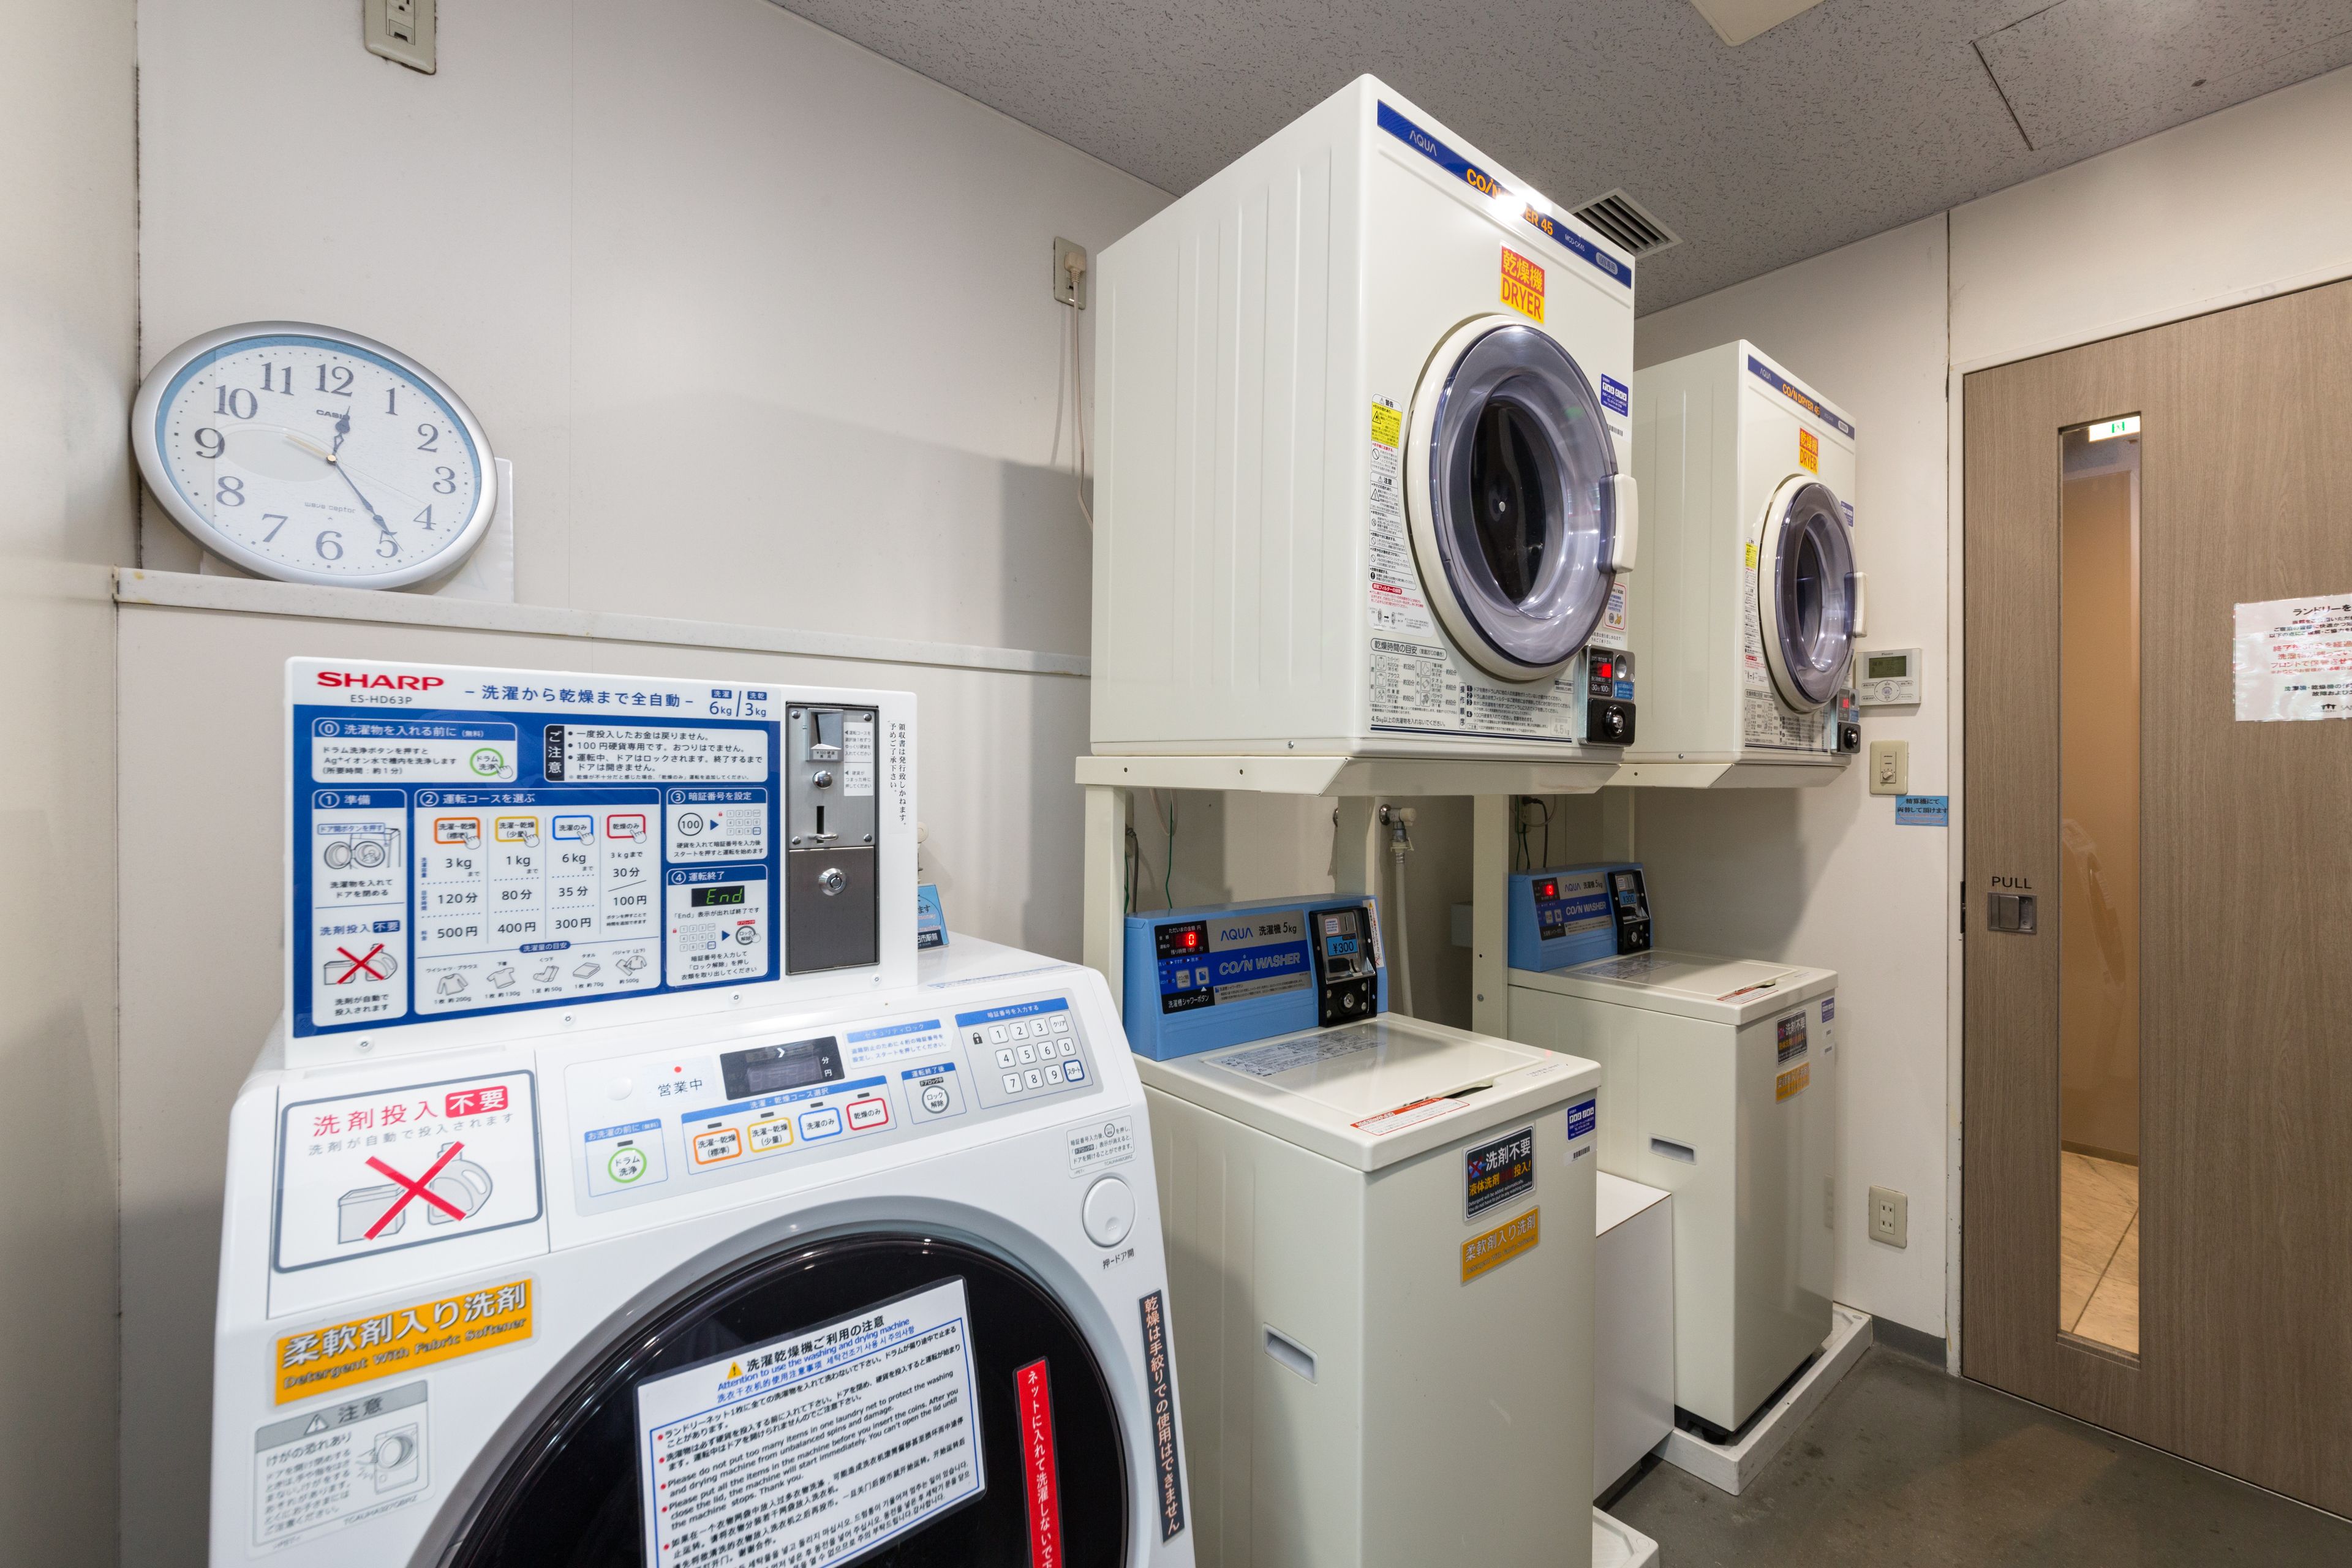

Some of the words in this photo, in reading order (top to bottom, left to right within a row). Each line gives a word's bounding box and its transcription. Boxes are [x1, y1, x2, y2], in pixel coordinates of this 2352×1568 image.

[1409, 130, 1437, 156] AQUA
[1541, 219, 1553, 235] 45
[1503, 250, 1542, 293] 乾燥機
[1502, 276, 1542, 319] DRYER
[260, 362, 294, 396] 11
[315, 364, 354, 397] 12
[214, 385, 258, 419] 10
[385, 387, 398, 415] 1
[1798, 394, 1813, 412] DRYER
[1814, 405, 1819, 416] 45
[195, 428, 225, 458] 9
[417, 424, 439, 452] 2
[1800, 450, 1817, 472] DRYER
[432, 467, 456, 494] 3
[216, 476, 245, 507] 8
[305, 502, 325, 510] wave
[328, 505, 356, 513] ceptor
[413, 503, 435, 530] 4
[262, 513, 288, 543] 7
[316, 530, 343, 560] 6
[376, 532, 398, 558] 5
[1374, 641, 1417, 655] 乾燥時間の目安
[317, 671, 444, 690] SHARP
[350, 695, 412, 704] ES-HD63P
[344, 724, 456, 737] 洗濯物を入れる前に
[577, 730, 709, 741] 一度投入したお金は戻りません。
[323, 747, 428, 755] ドラム洗浄ボタンを押すと
[548, 731, 562, 774] ご注意
[344, 795, 371, 805] 準備
[443, 794, 535, 804] 運転コースを選ぶ
[682, 820, 699, 829] 100
[674, 848, 763, 857] スタートを押すと運転を始めます
[330, 879, 393, 889] 洗濯物を入れて
[688, 872, 725, 881] 運転終了
[1992, 876, 2032, 889] PULL
[336, 889, 389, 899] ドアを閉める
[1565, 883, 1581, 892] AQUA
[706, 888, 743, 904] End
[1584, 902, 1606, 912] WASHER
[320, 924, 370, 936] 洗剤投入
[375, 922, 399, 932] 不要
[1221, 927, 1253, 941] AQUA
[1259, 925, 1281, 935] 洗濯機
[1283, 922, 1297, 934] 5kg
[523, 943, 567, 952] 洗濯量の目安
[1189, 934, 1194, 945] 0
[1333, 940, 1354, 954] ¥300
[691, 951, 747, 962] 暗証番号を入力して
[1256, 953, 1300, 970] WASHER
[681, 967, 756, 980] 衣類を取り出してください
[335, 994, 389, 1005] 洗剤が自動で
[1169, 995, 1209, 1008] 洗濯槽シャワーボタン
[335, 1005, 388, 1016] 投入されます
[987, 1005, 1039, 1019] 暗証番号を入力する
[996, 1030, 1001, 1039] 1
[1016, 1027, 1023, 1036] 2
[1037, 1023, 1042, 1032] 3
[1003, 1054, 1009, 1063] 4
[1024, 1050, 1030, 1059] 5
[1044, 1046, 1051, 1055] 6
[1064, 1042, 1070, 1052] 0
[911, 1066, 946, 1078] 運転終了後
[1010, 1079, 1016, 1088] 7
[1031, 1075, 1038, 1084] 8
[1051, 1071, 1057, 1080] 9
[1067, 1066, 1081, 1076] スタート
[658, 1078, 703, 1098] 営業中
[927, 1092, 943, 1101] ロック
[931, 1100, 944, 1109] 解除
[312, 1101, 438, 1137] 洗剤投入
[448, 1088, 505, 1115] 不要
[854, 1109, 881, 1120] 乾燥のみ
[587, 1123, 639, 1140] お洗濯の前に
[805, 1118, 835, 1130] 洗濯のみ
[308, 1114, 514, 1156] 洗剤が自動で投入されます
[615, 1157, 641, 1166] ドラム
[1485, 1137, 1531, 1171] 洗剤不要
[619, 1167, 637, 1176] 洗浄
[1469, 1175, 1499, 1196] 液体洗剤
[1465, 1213, 1536, 1262] 柔軟剤入り洗剤
[281, 1282, 526, 1368] 柔軟剤入り洗剤
[747, 1315, 884, 1372] 洗濯乾燥機ご利用の注意
[865, 1340, 878, 1351] 사용
[283, 1359, 368, 1390] Detergent
[414, 1334, 461, 1355] Fabric
[465, 1317, 526, 1341] Softener
[718, 1373, 758, 1391] Attention
[772, 1364, 786, 1373] use
[788, 1359, 802, 1368] the
[804, 1346, 837, 1365] washing
[839, 1338, 853, 1349] and
[855, 1330, 878, 1347] drying
[880, 1319, 910, 1335] machine
[338, 1396, 383, 1423] 注意
[1144, 1297, 1179, 1536] 乾燥は手絞りでの使用はできません
[668, 1469, 696, 1488] Please
[712, 1461, 726, 1471] not
[729, 1455, 743, 1466] put
[746, 1449, 760, 1460] too
[761, 1439, 784, 1455] many
